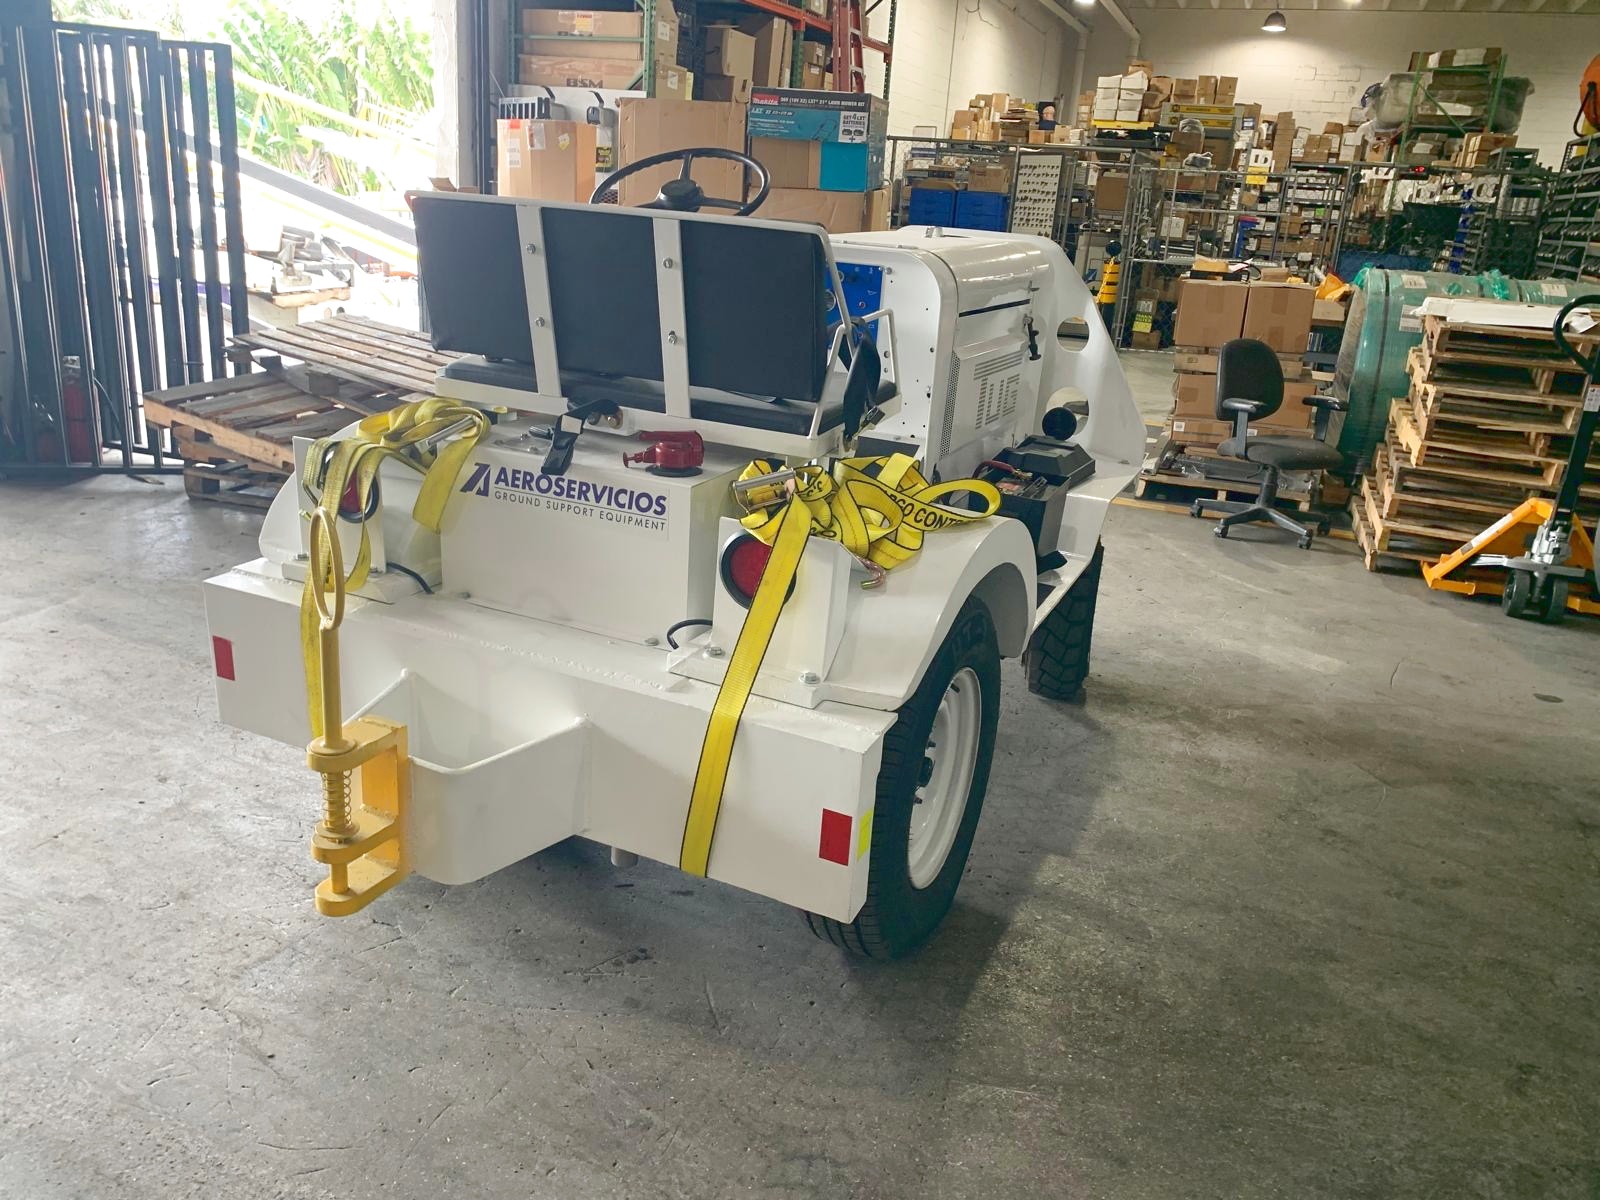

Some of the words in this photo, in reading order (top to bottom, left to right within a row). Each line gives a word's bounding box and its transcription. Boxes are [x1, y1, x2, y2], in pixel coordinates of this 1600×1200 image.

[566, 78, 603, 88] BSM
[494, 467, 667, 516] AEROSERVICIOS
[494, 490, 541, 507] GROUND
[546, 501, 595, 517] SUPPORT
[599, 510, 666, 532] EQUIPMENT
